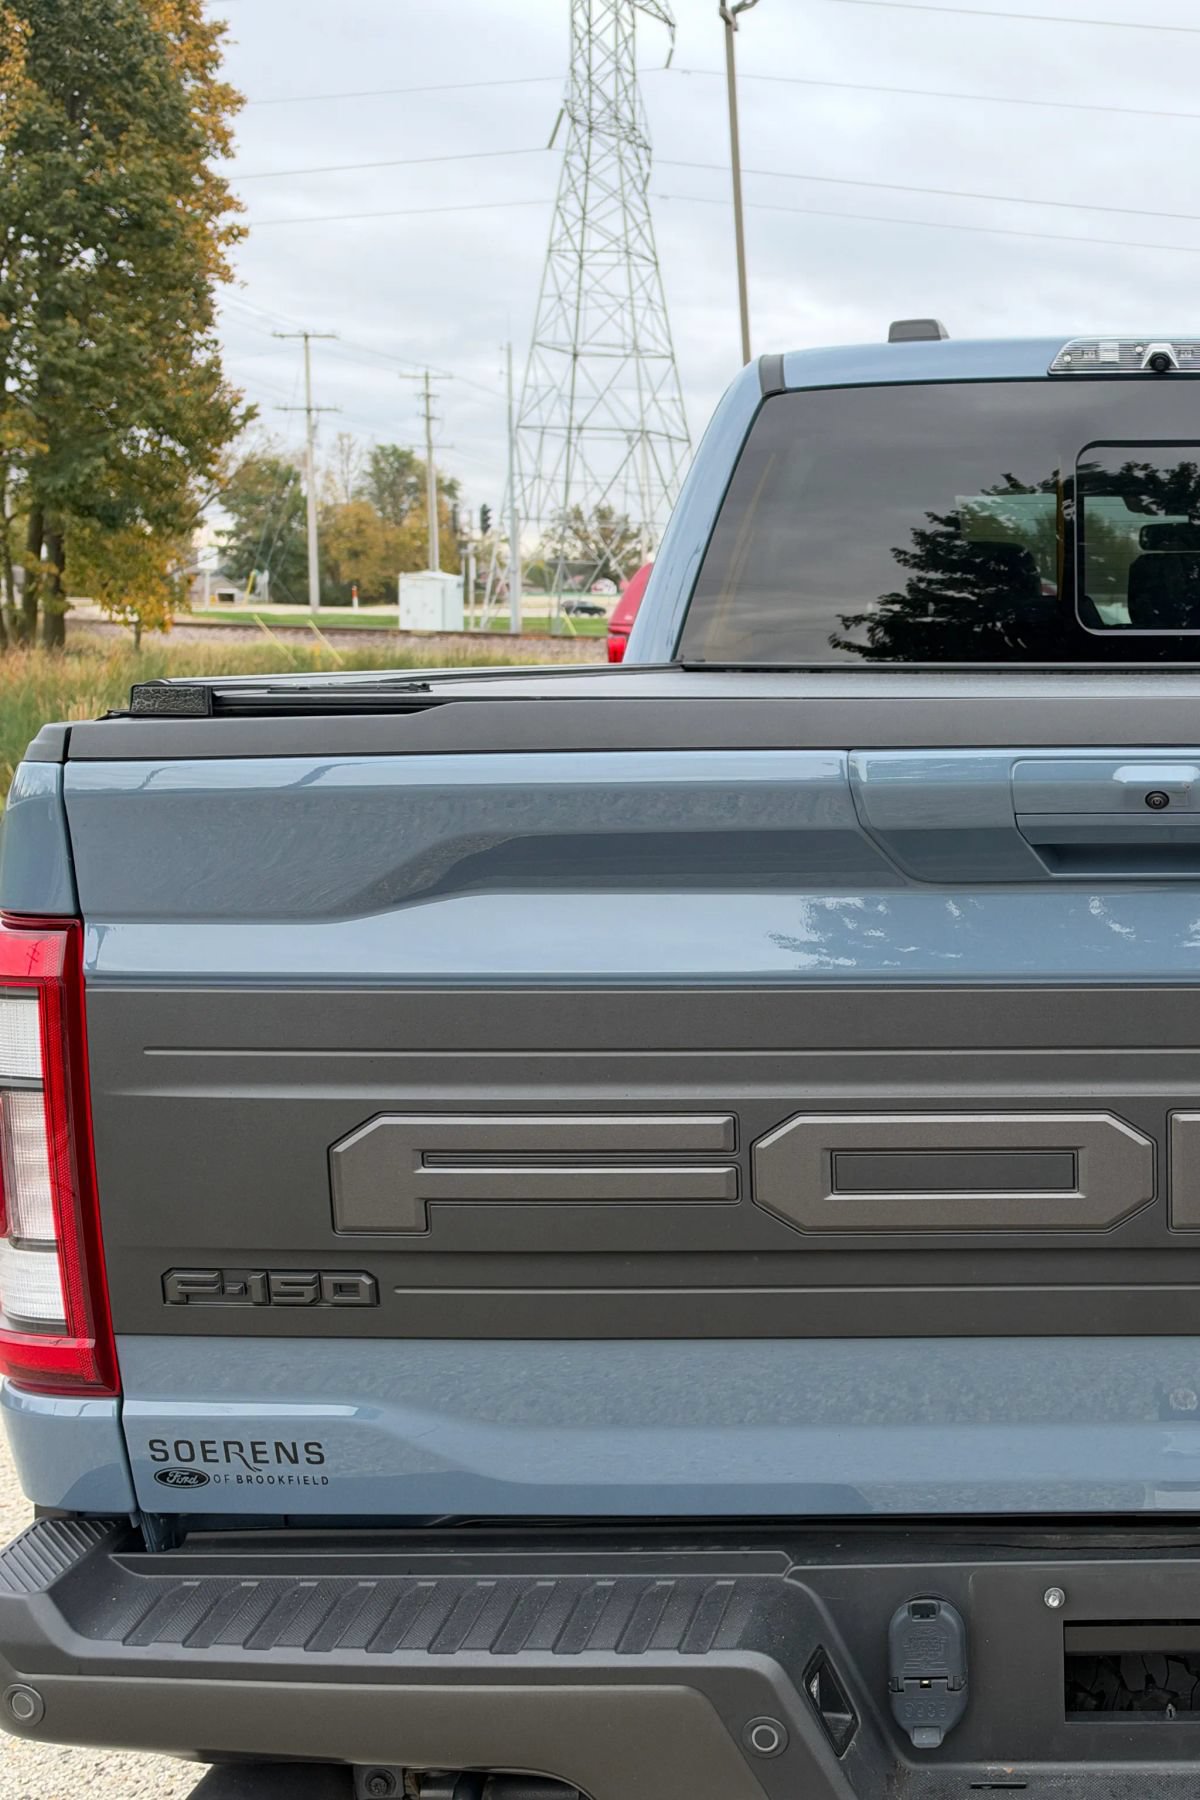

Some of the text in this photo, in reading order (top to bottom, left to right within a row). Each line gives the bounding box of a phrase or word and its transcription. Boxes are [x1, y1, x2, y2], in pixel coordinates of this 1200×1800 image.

[161, 1267, 380, 1307] F-150
[148, 1439, 326, 1471] SOERENS
[162, 1469, 329, 1487] Ford OF BROOKFIELD
